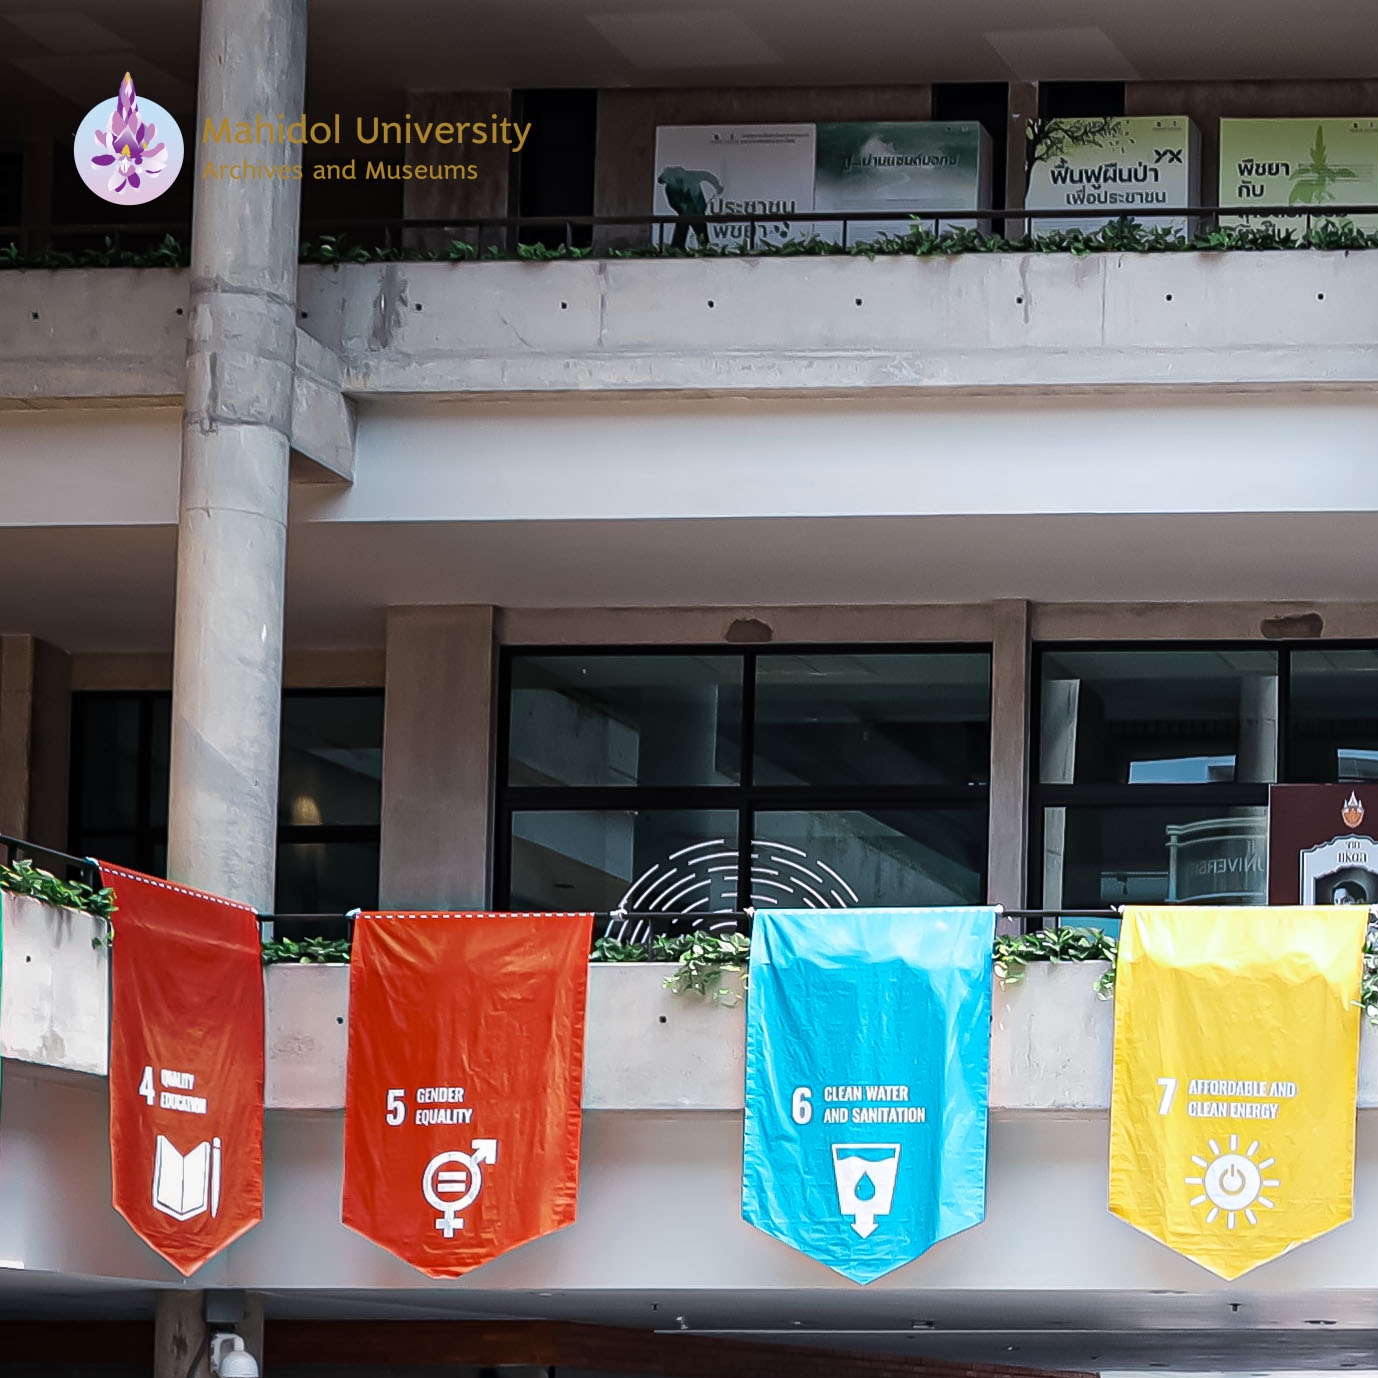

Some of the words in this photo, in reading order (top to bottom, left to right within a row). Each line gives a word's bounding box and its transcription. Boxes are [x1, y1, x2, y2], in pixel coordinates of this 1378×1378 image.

[1237, 180, 1265, 198] กับ
[139, 1066, 155, 1105] 4
[160, 1069, 195, 1091] QUALITY
[1187, 1080, 1266, 1098] AFFORDABLE
[1269, 1080, 1297, 1098] AND
[160, 1092, 207, 1114] EDUCATION
[416, 1087, 464, 1104] GENDER
[823, 1086, 863, 1103] CLEAN
[866, 1085, 909, 1102] WATER
[1157, 1077, 1178, 1116] 7
[386, 1089, 407, 1126] 5
[792, 1087, 813, 1125] 6
[823, 1107, 850, 1124] AND
[852, 1106, 926, 1124] SANITATION
[1187, 1102, 1228, 1119] CLEAN
[1230, 1102, 1279, 1120] ENERGY
[415, 1107, 473, 1126] EQUALITY
